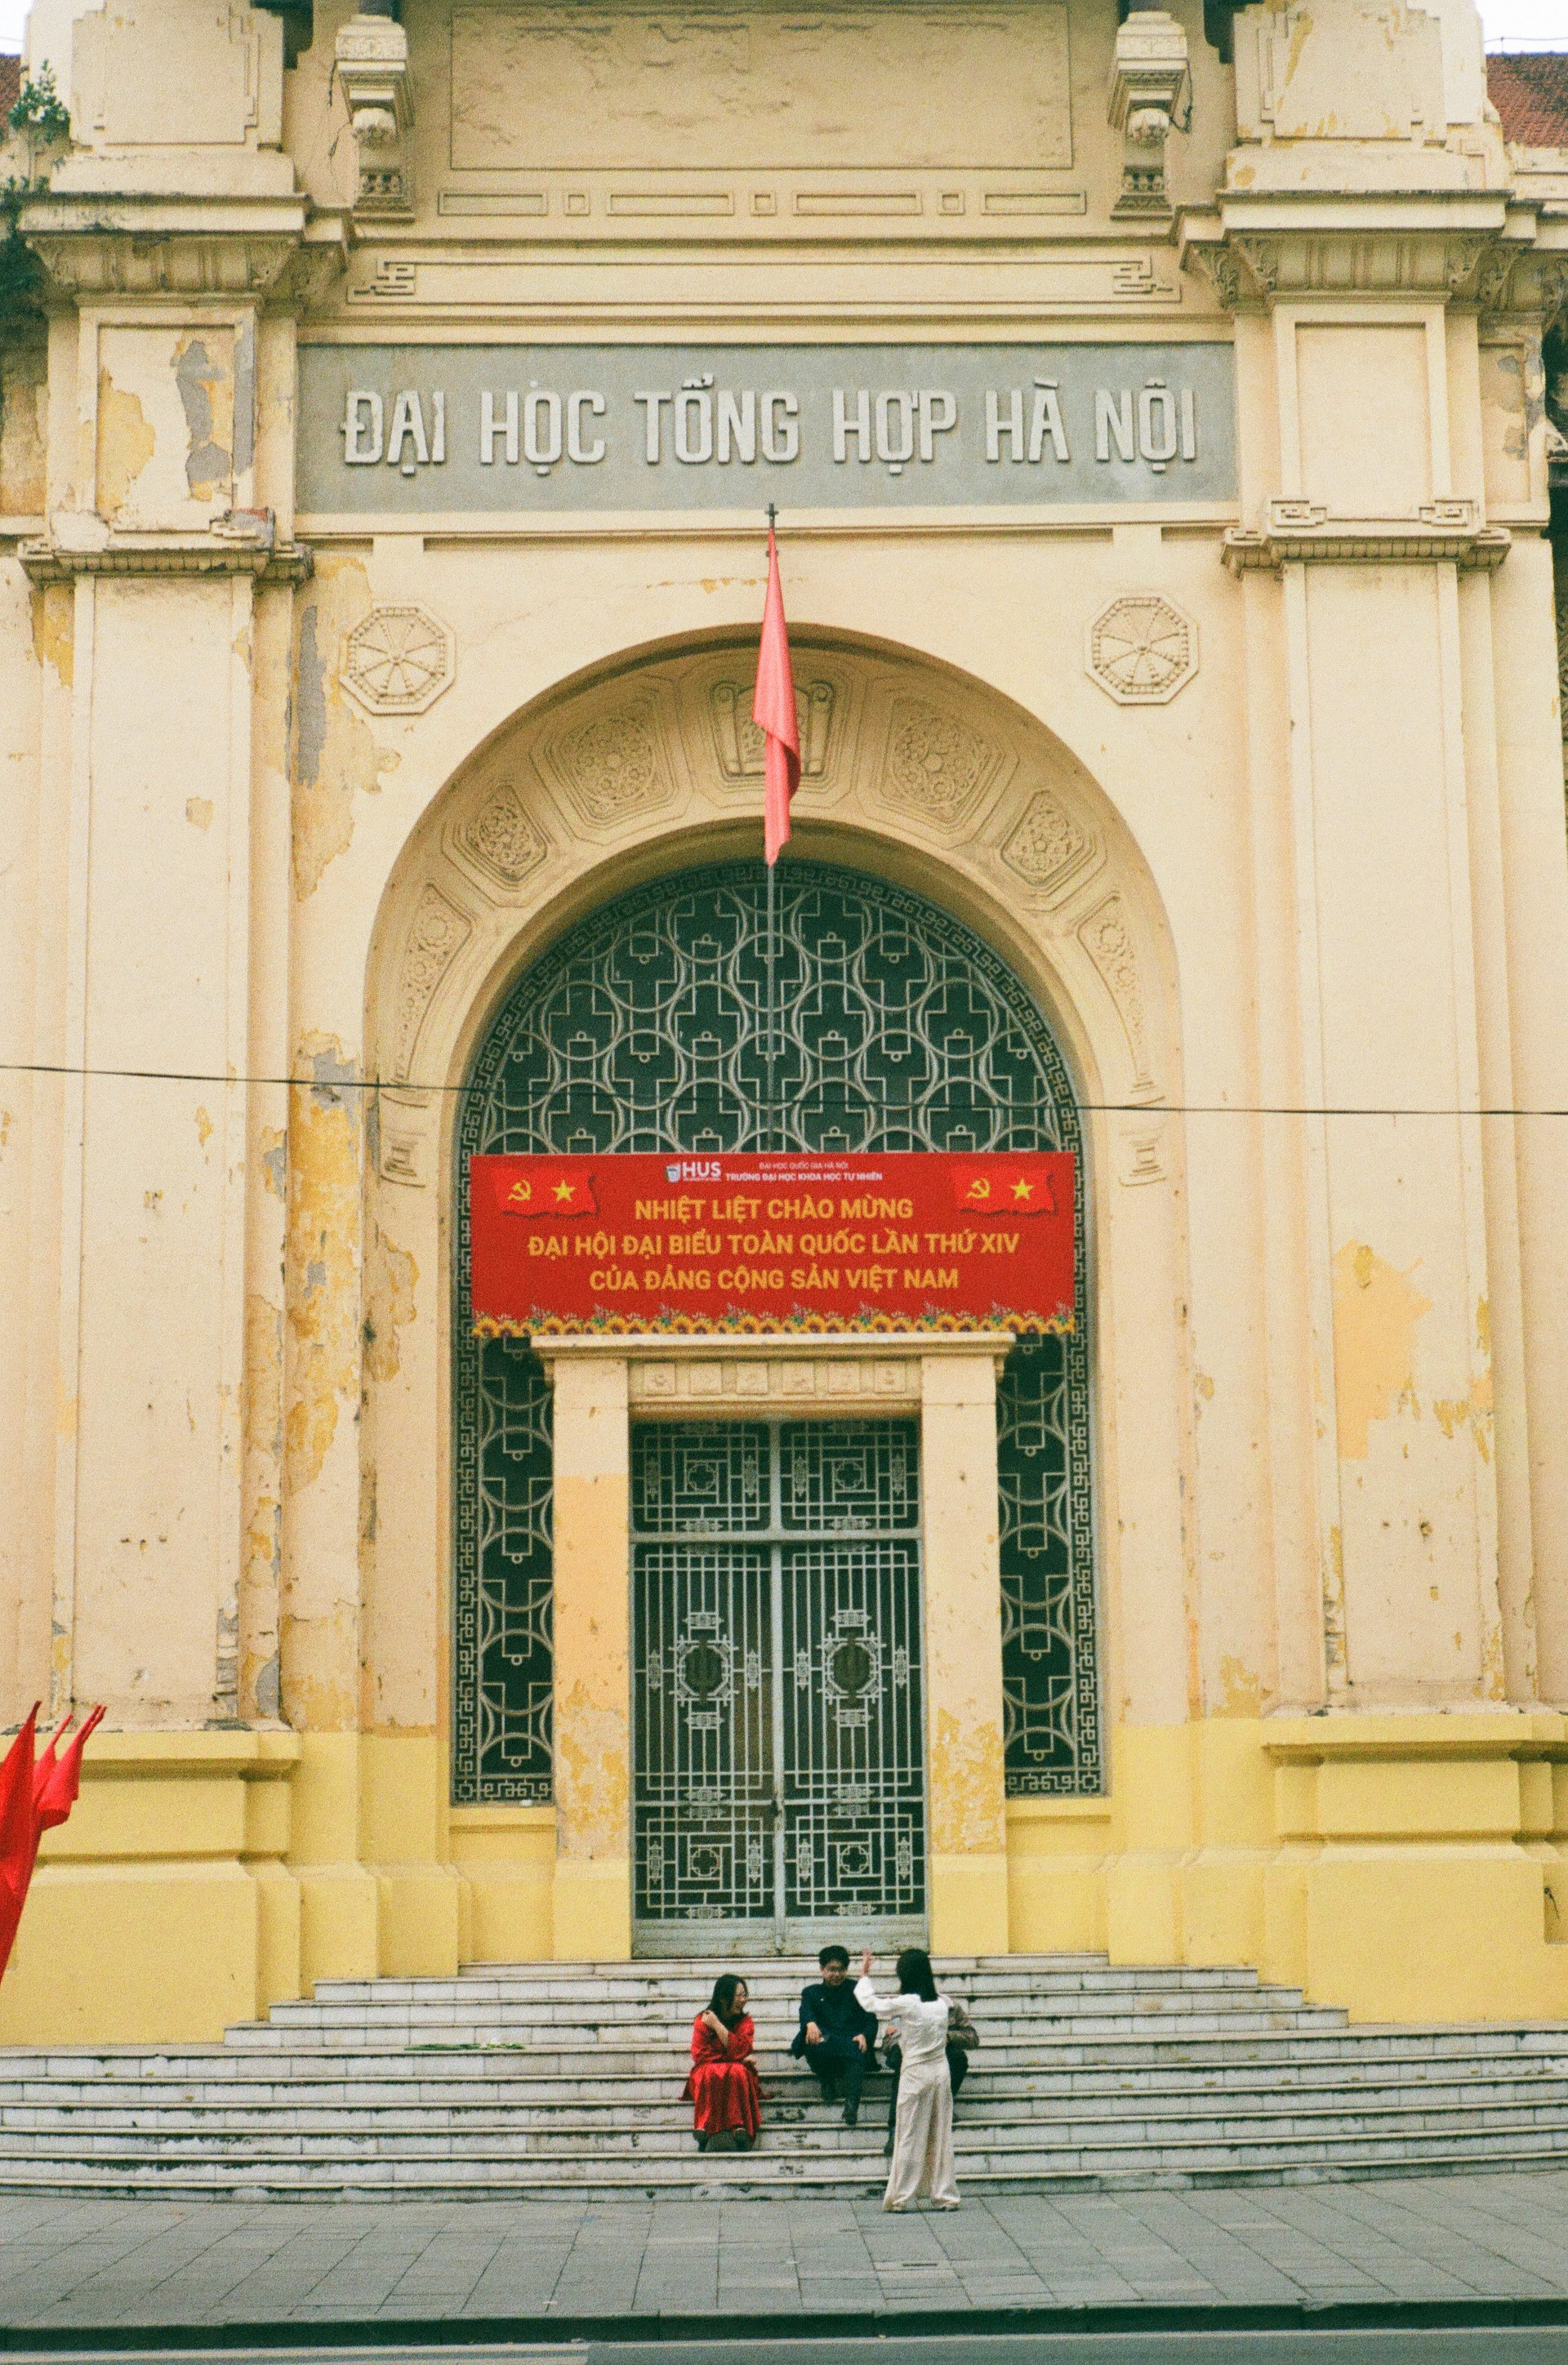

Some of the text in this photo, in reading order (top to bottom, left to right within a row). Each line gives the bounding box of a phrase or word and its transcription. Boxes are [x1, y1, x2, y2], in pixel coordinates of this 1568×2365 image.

[341, 373, 1195, 475] ĐẠI HỌC TỔNG HỢP HÀ NỘI
[681, 1161, 722, 1178] HUS
[798, 1173, 822, 1181] KHOA
[635, 1195, 914, 1224] NHIỆT LIỆT CHÀO MỪNG
[528, 1227, 1020, 1260] ĐẠI HỘI ĐẠI BIỂU TOÀN QUỐC LẦN THỨ XIV
[590, 1263, 959, 1294] CỦA ĐẢNG CỘNG SẢN VIỆT NAM
